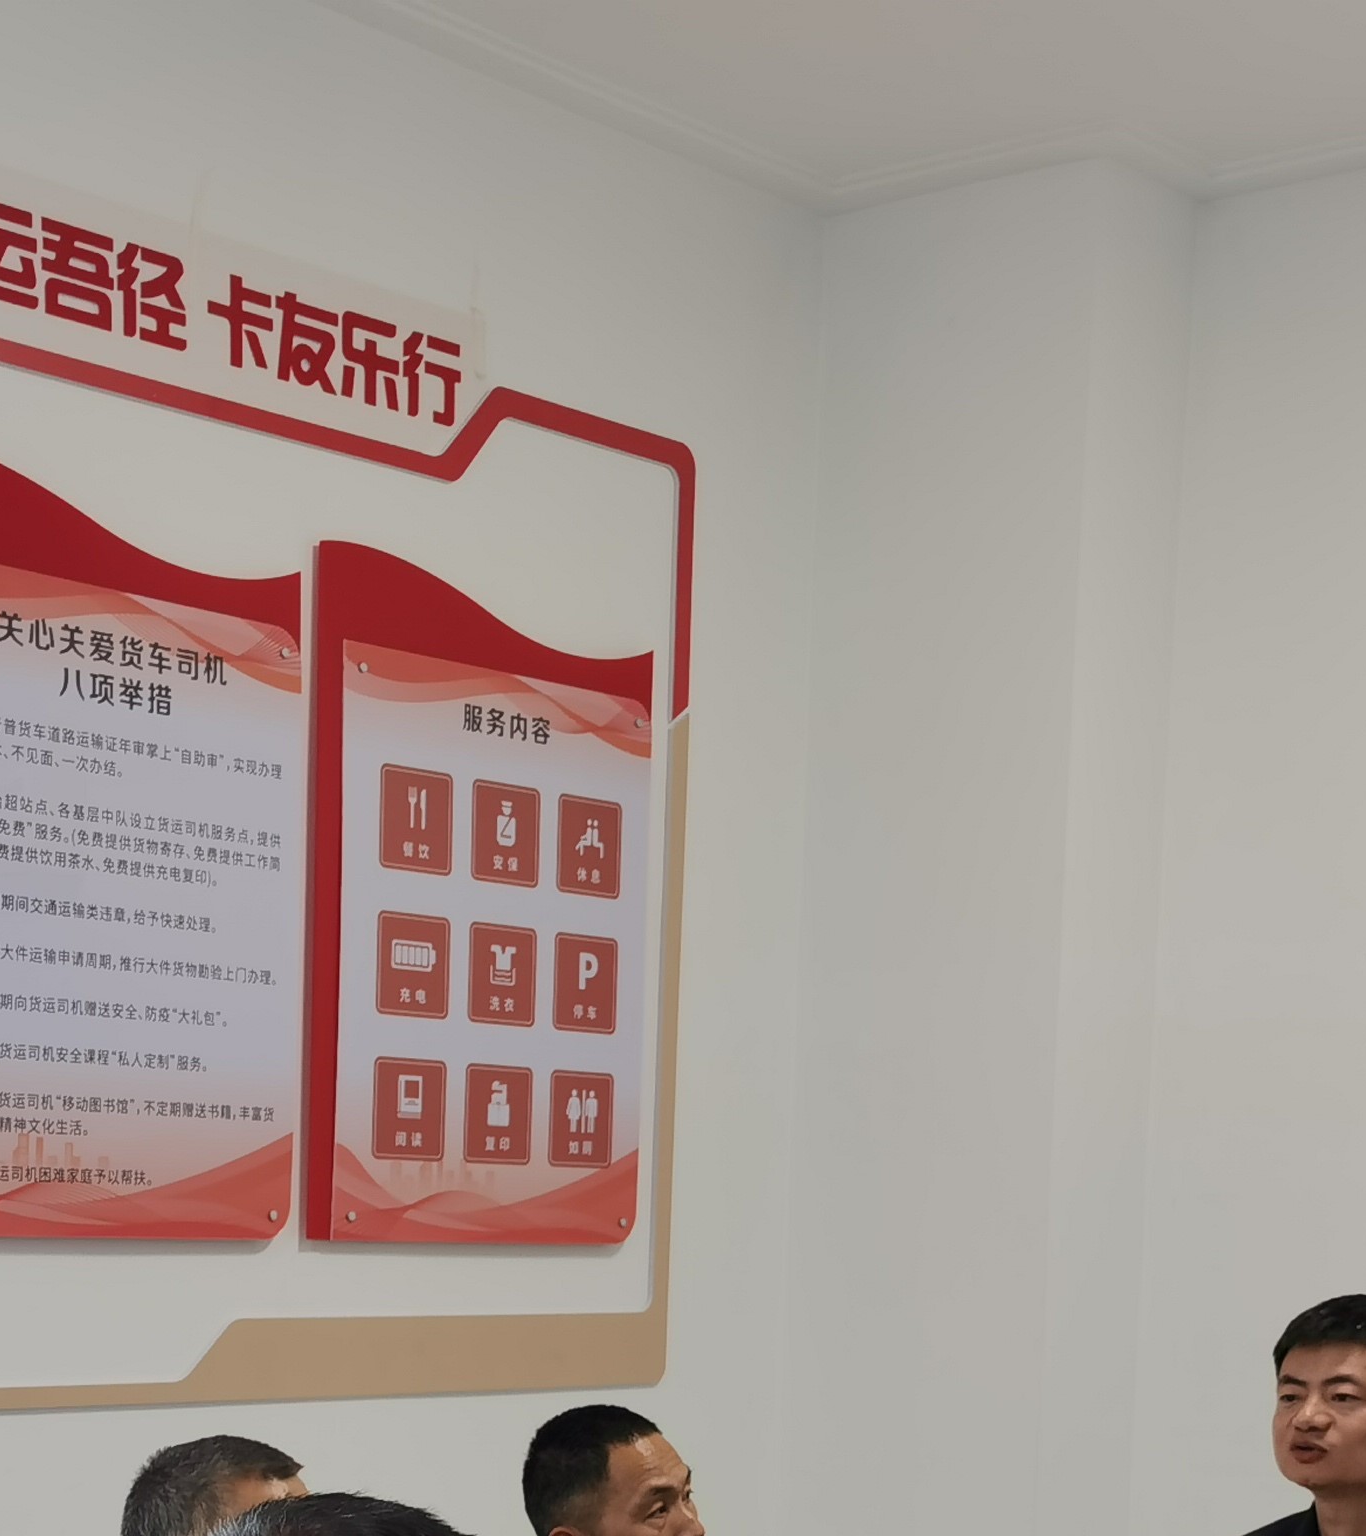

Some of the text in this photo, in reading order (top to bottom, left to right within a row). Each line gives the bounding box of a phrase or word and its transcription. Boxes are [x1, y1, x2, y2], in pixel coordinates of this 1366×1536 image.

[207, 273, 462, 427] 卡友乐行
[59, 666, 172, 717] 八项举措
[463, 703, 551, 745] 服务内容
[402, 841, 431, 860] 餐饮
[492, 854, 519, 872] 安保
[576, 866, 602, 884] 休息
[578, 952, 599, 990] P
[399, 987, 427, 1004] 充电
[489, 996, 515, 1013] 洗衣
[572, 1004, 598, 1020] 停车
[394, 1131, 423, 1148] 阅读
[485, 1135, 511, 1152] 复印
